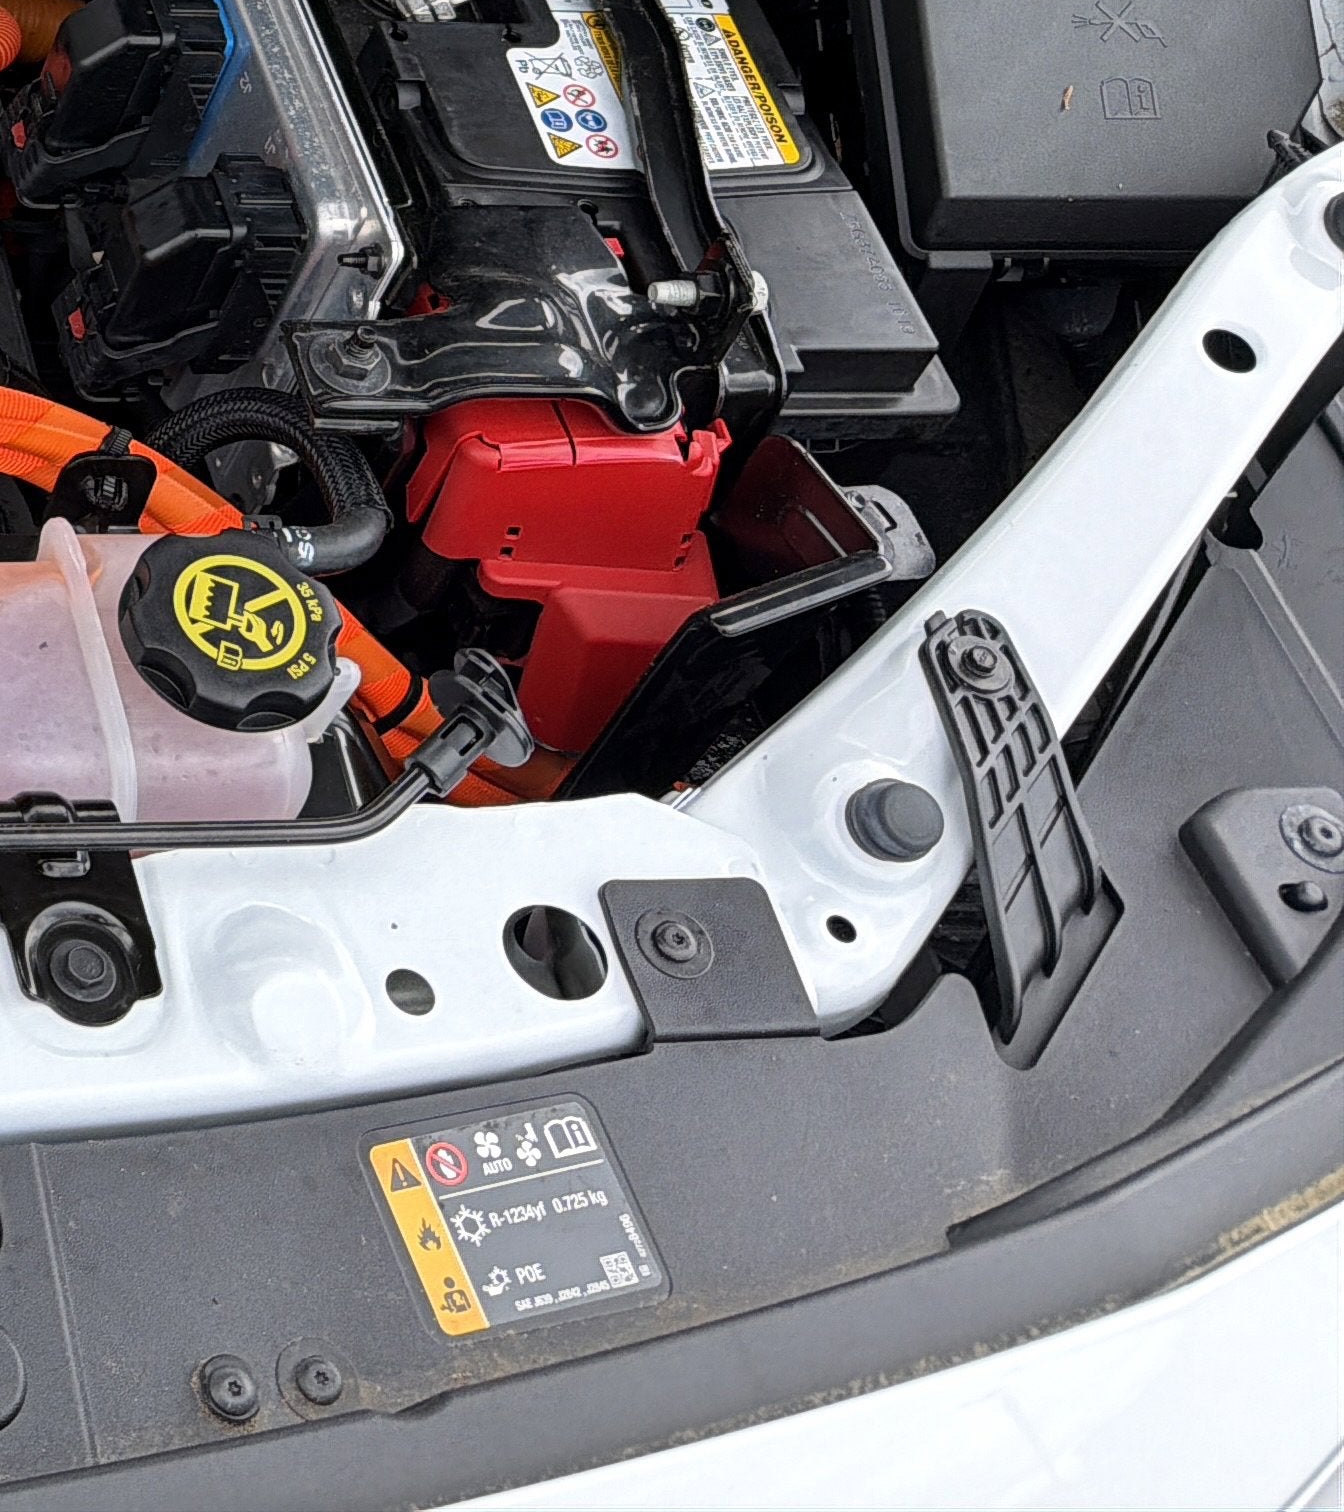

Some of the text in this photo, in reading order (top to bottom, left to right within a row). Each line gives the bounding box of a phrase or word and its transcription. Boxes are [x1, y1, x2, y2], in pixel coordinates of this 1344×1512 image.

[513, 59, 529, 74] Pb
[728, 39, 787, 143] DANGER/POISON
[296, 582, 325, 622] 35 kPa
[287, 652, 318, 680] 5 PSI
[483, 1158, 512, 1176] AUTO
[489, 1189, 608, 1229] R-1234yf 0.725 kg
[515, 1263, 546, 1284] POE
